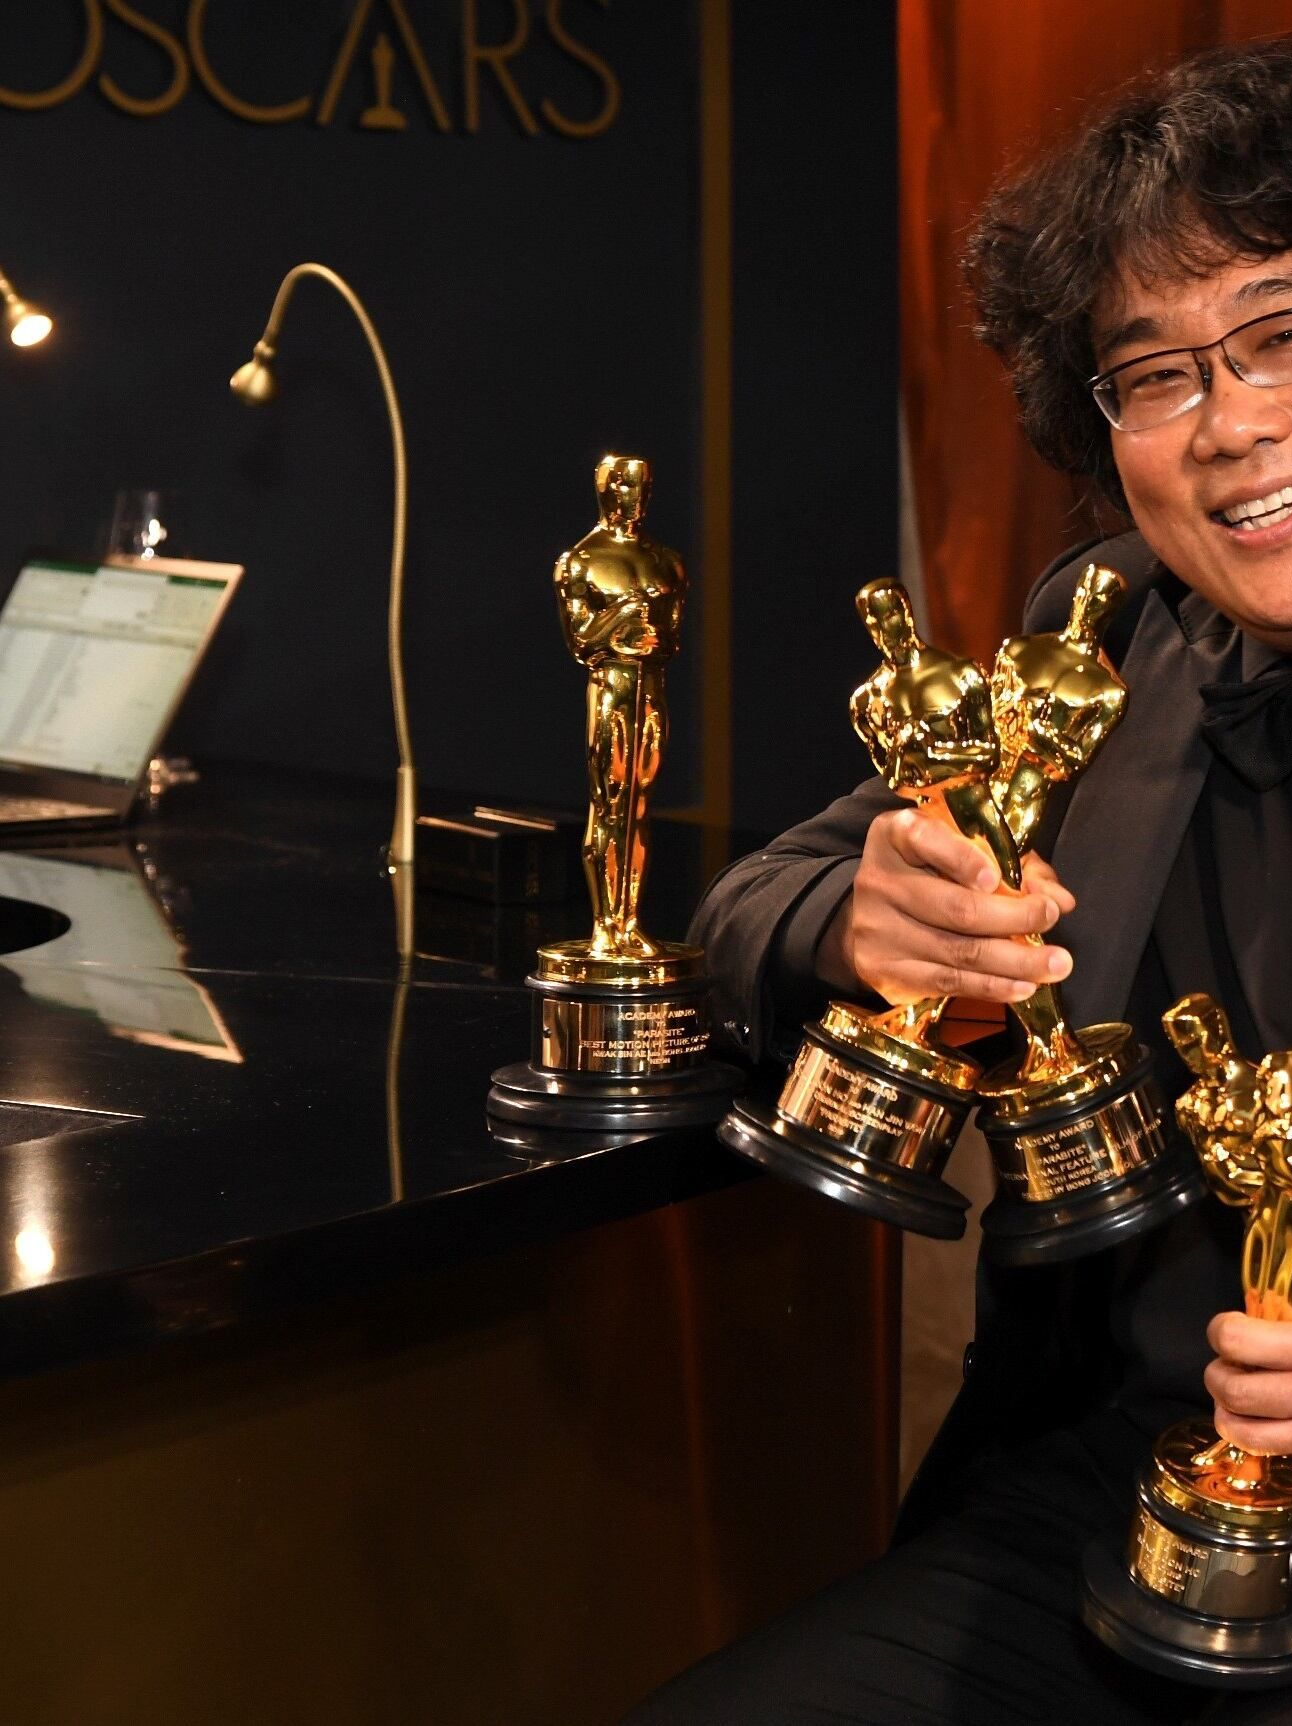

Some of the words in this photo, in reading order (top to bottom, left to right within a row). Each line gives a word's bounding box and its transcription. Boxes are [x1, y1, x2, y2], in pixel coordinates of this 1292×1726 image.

[0, 0, 624, 138] OSCARS
[618, 1011, 666, 1021] ACADEMY
[666, 1009, 696, 1019] AWARD
[633, 1028, 685, 1038] "PARASITE"
[580, 1041, 606, 1049] BEST
[608, 1041, 650, 1049] MOTION
[652, 1036, 690, 1048] PICTURE
[1059, 1119, 1095, 1138] AWARD
[1050, 1143, 1060, 1151] TO
[1060, 1149, 1108, 1172] FEATURE
